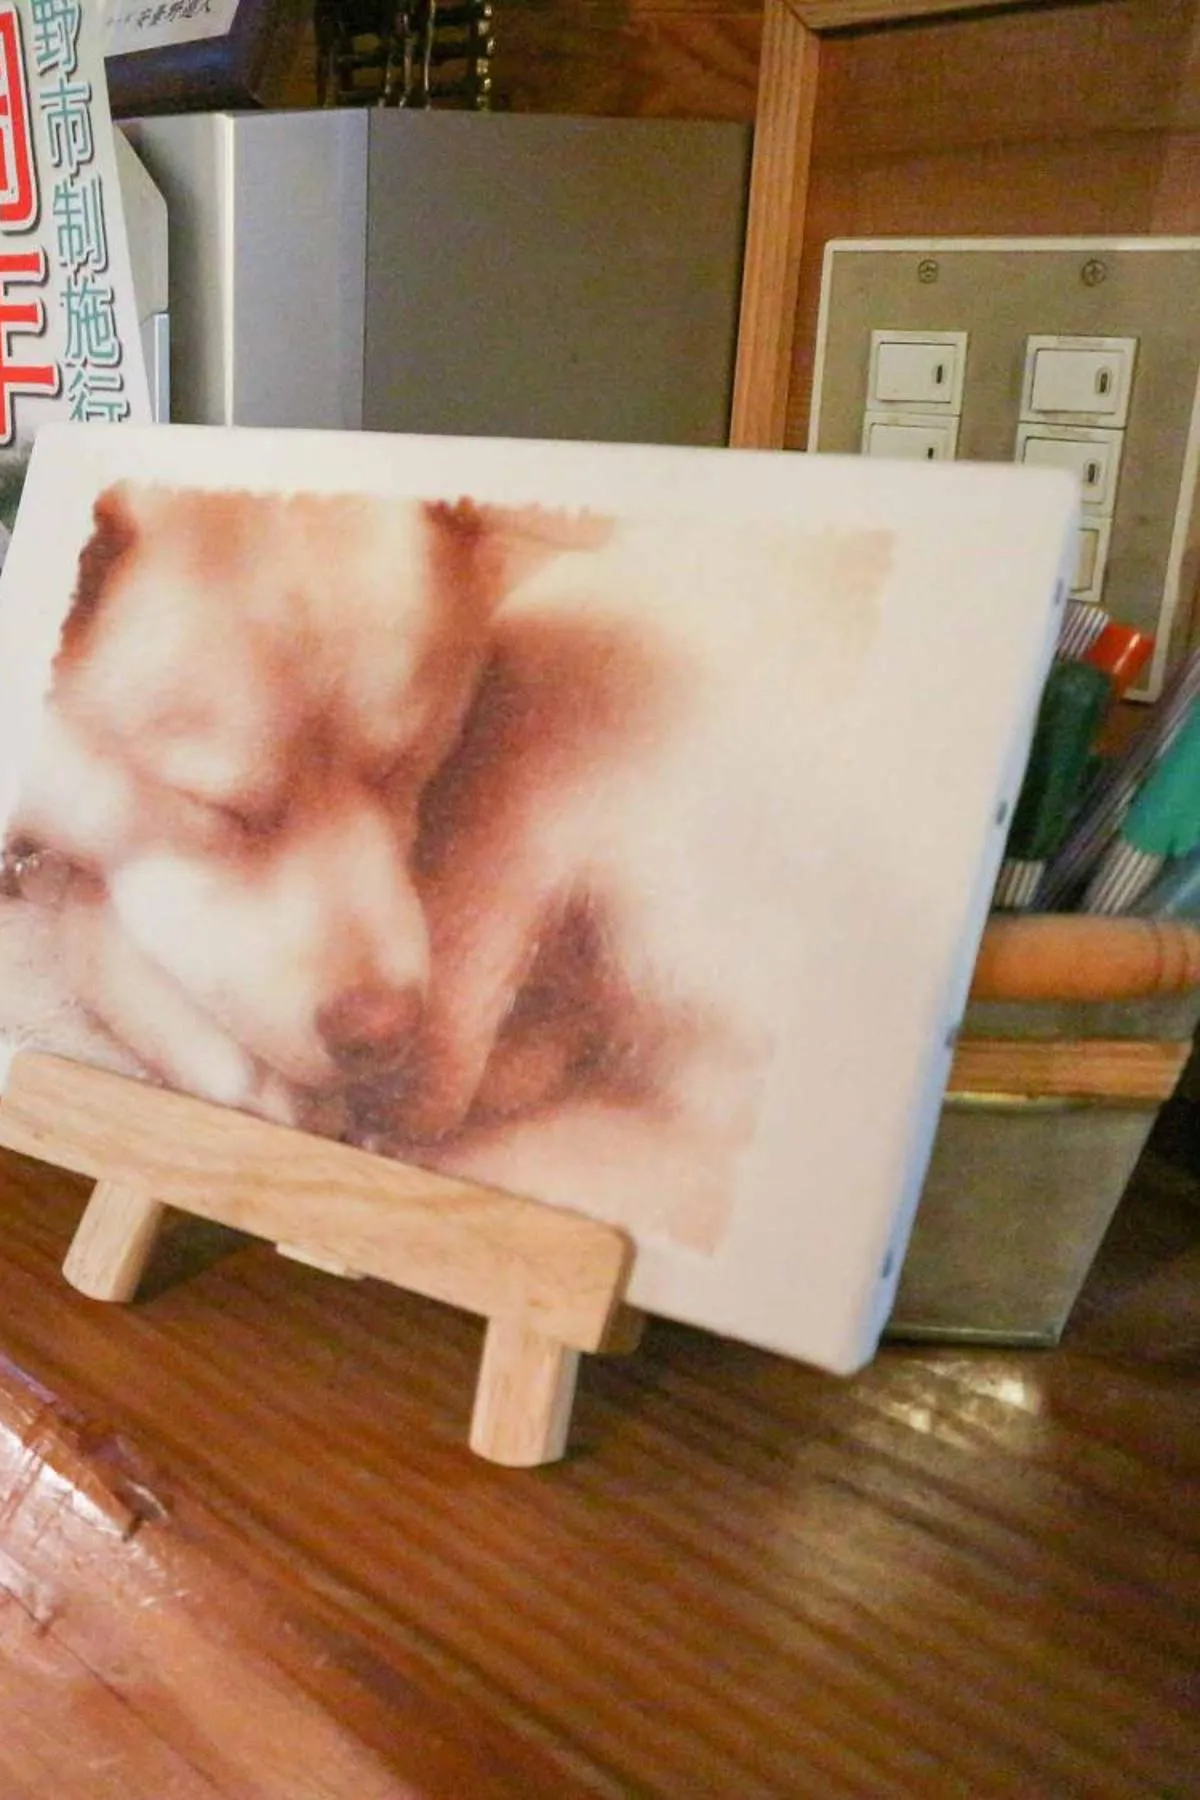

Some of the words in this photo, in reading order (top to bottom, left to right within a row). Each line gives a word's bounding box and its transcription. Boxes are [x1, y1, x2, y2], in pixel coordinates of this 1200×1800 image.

[30, 0, 124, 421] 野市制施行
